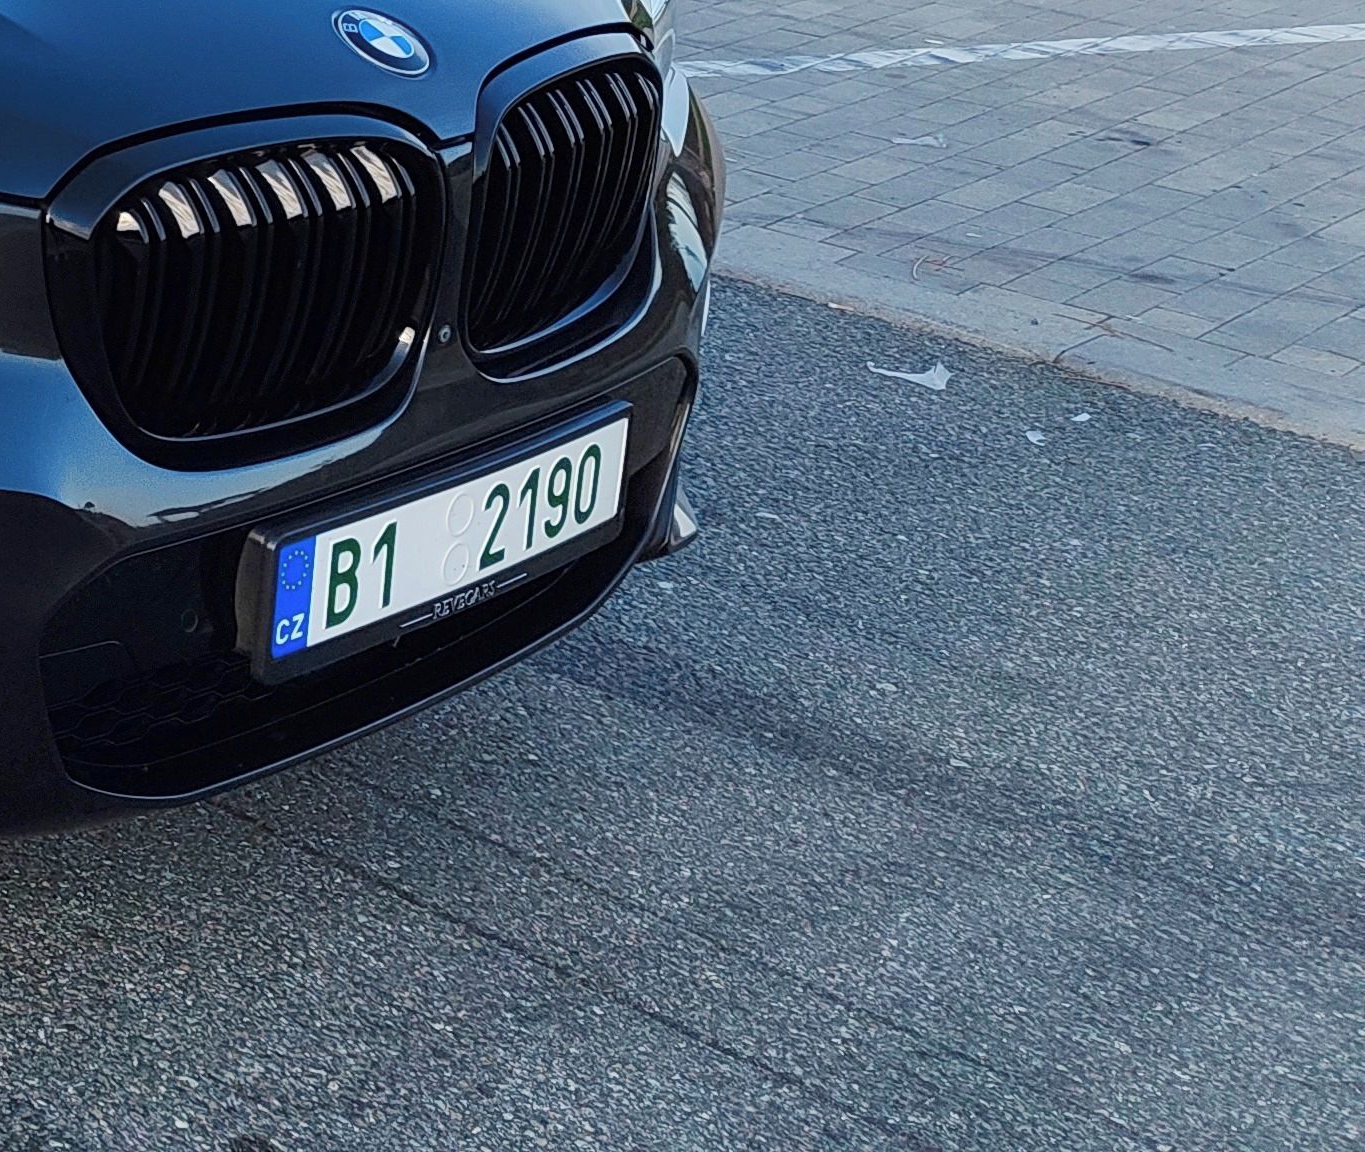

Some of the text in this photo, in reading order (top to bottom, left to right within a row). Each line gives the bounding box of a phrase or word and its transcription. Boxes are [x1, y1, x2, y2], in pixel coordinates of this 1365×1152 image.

[325, 443, 602, 630] B1 2190
[276, 613, 304, 646] CZ
